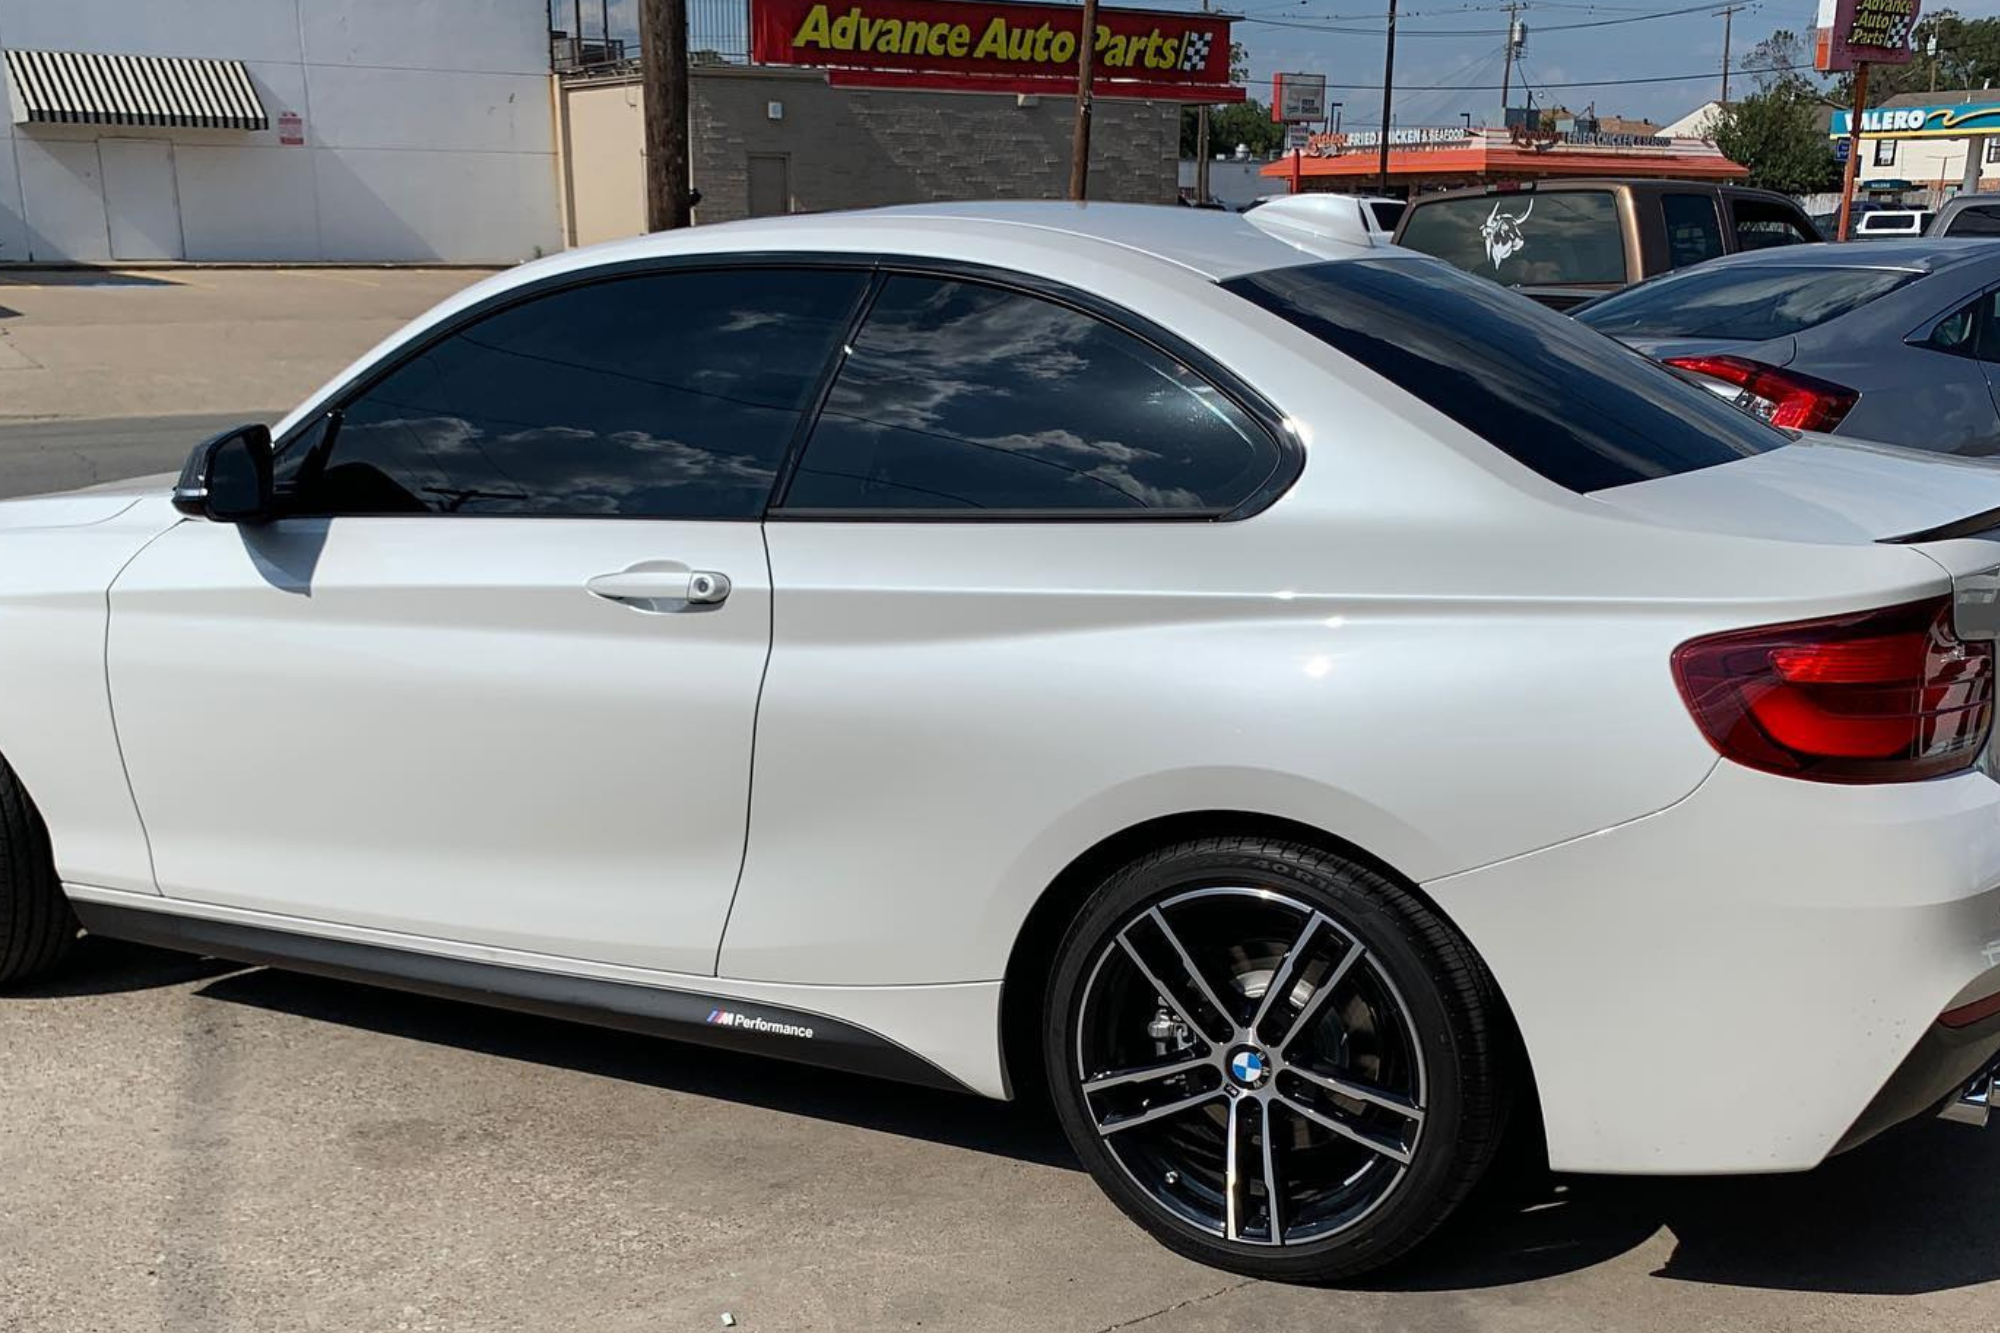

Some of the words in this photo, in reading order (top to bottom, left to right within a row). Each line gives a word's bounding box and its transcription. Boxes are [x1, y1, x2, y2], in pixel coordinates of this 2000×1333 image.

[1860, 0, 1914, 13] Advance
[1857, 11, 1889, 28] Auto
[792, 4, 971, 57] Advance
[973, 17, 1076, 63] Auto
[1852, 28, 1885, 45] Parts
[1349, 131, 1377, 146] FRIED
[735, 1013, 814, 1038] Performance
